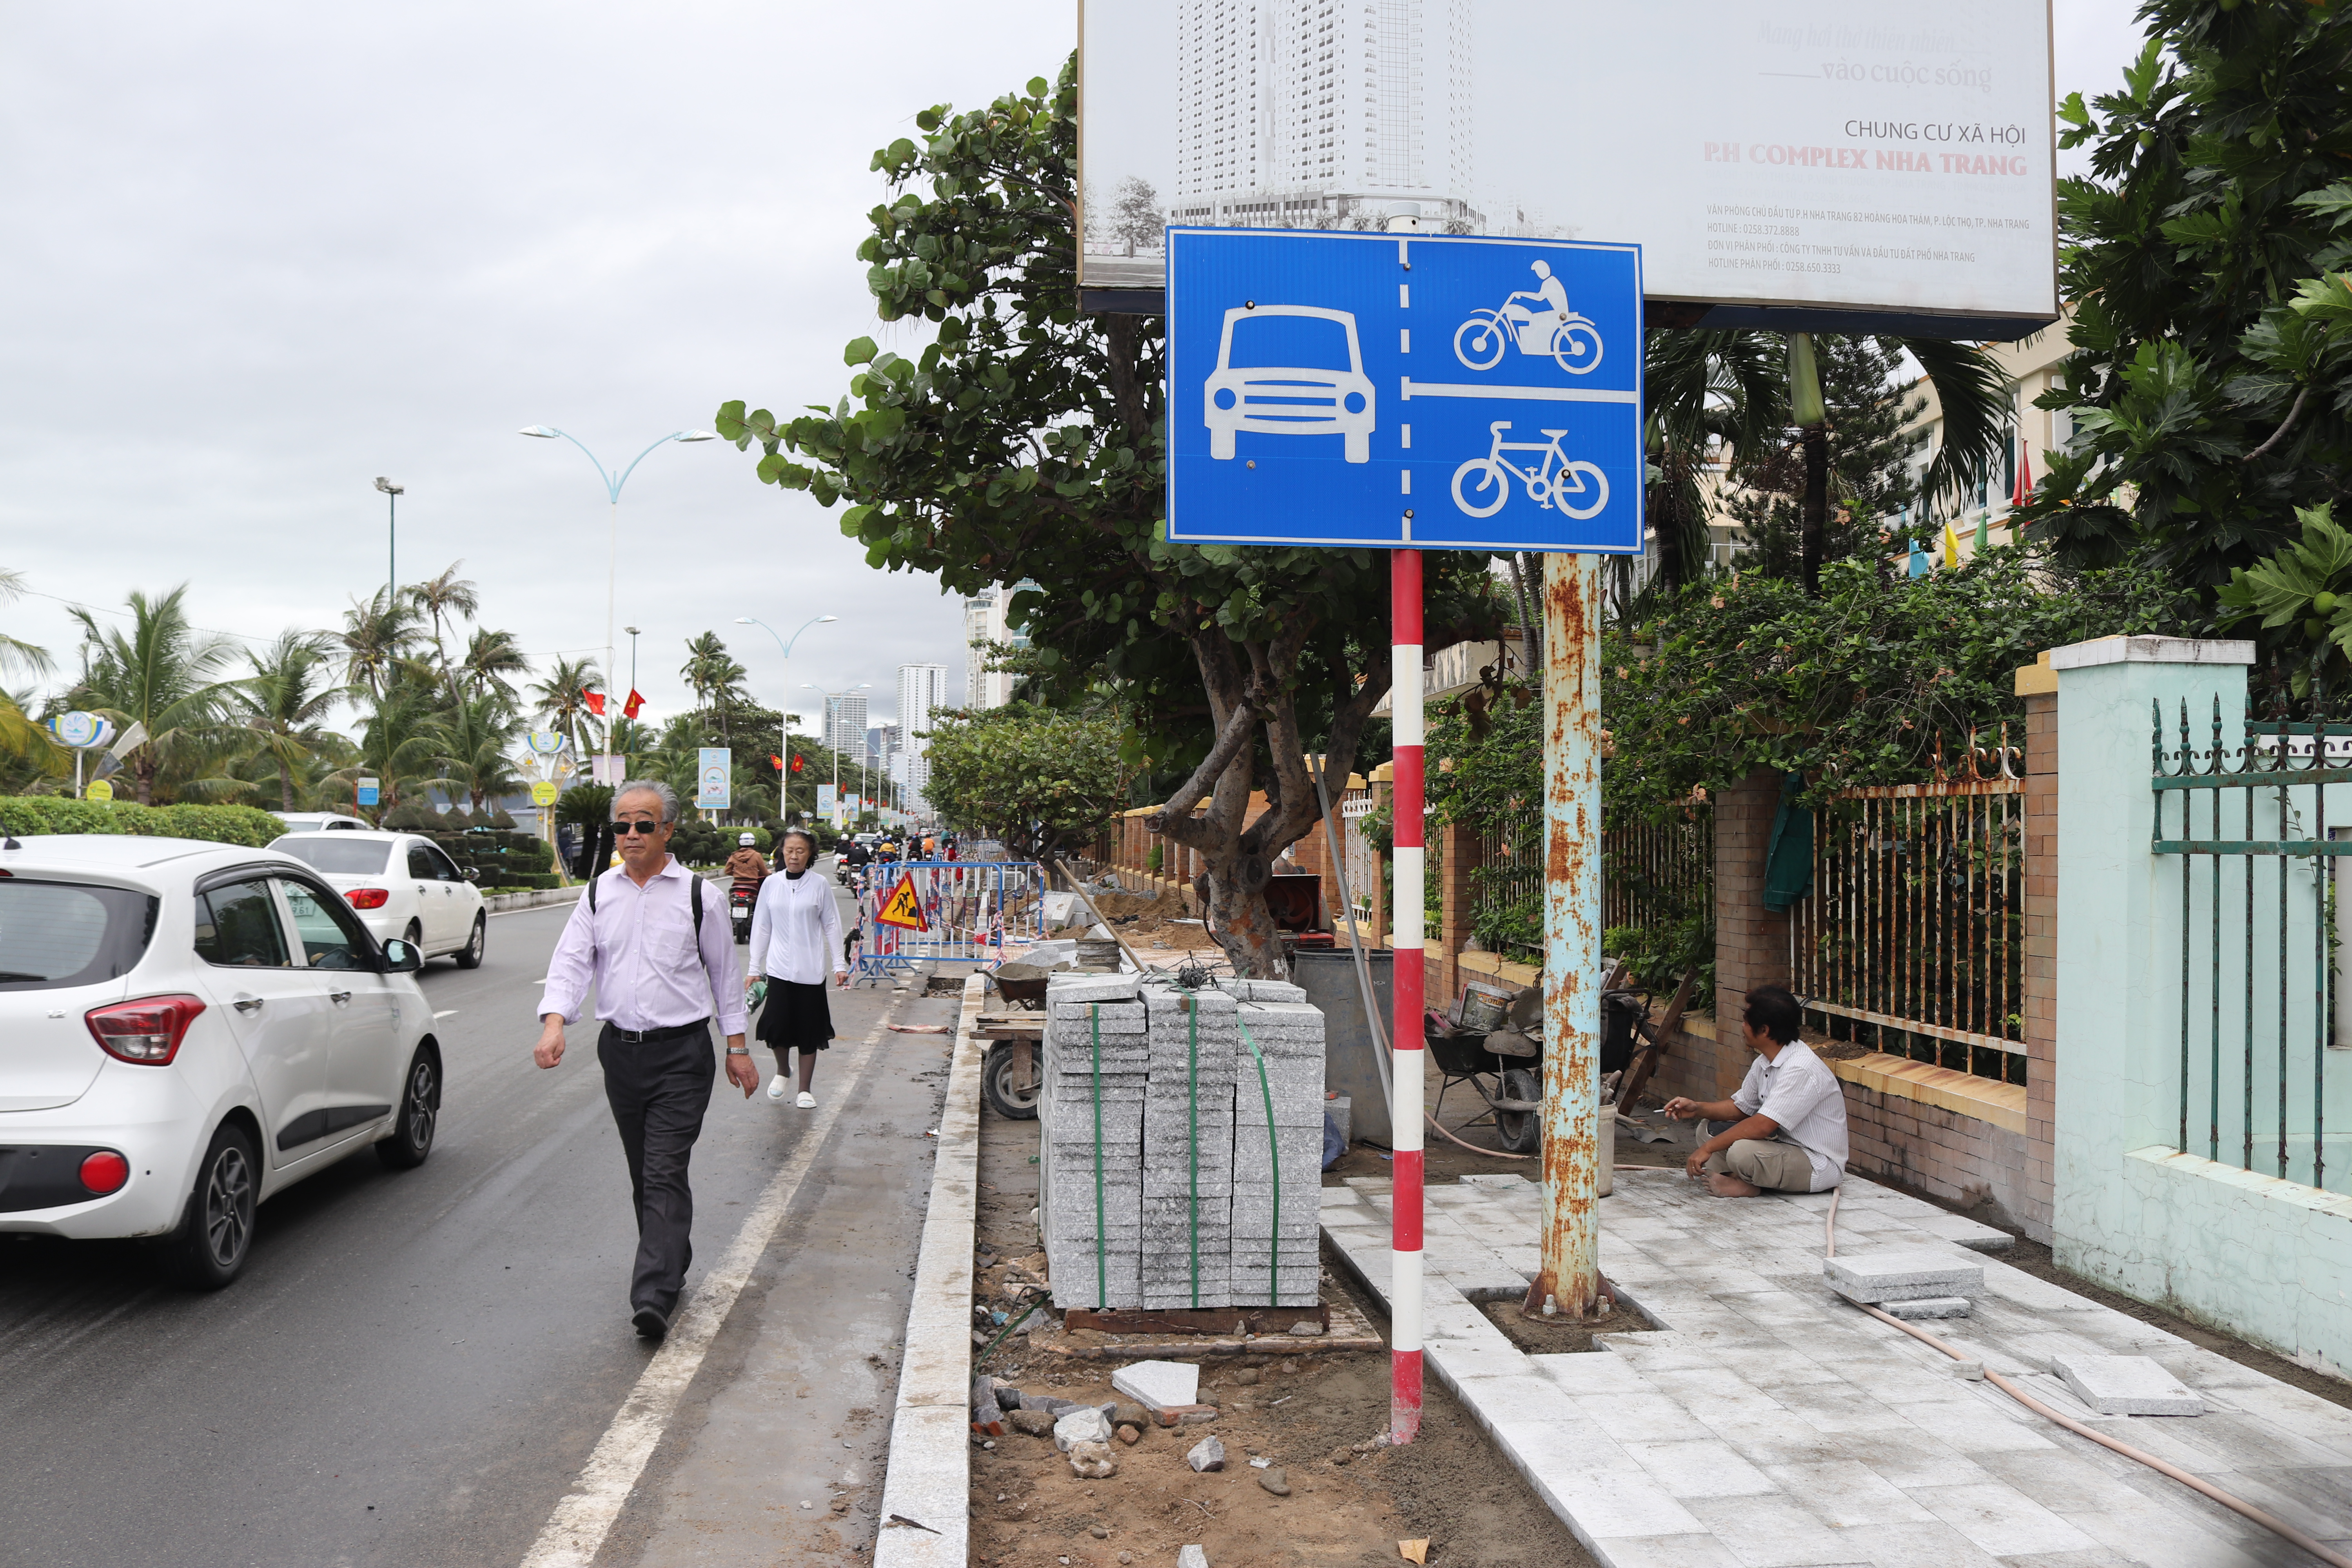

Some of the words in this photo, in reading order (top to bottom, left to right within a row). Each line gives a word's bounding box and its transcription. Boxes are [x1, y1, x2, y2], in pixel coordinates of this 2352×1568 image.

[1821, 56, 1866, 82] vào
[1870, 60, 1930, 88] cuộc
[1934, 59, 1992, 94] sống
[1845, 120, 1918, 140] CHUNG
[1924, 123, 1953, 141] CƯ
[1958, 123, 1984, 143] XÃ
[1991, 124, 2025, 148] HỘI
[1705, 142, 1740, 162] P.H
[1749, 144, 1868, 169] COMPLEX
[1875, 150, 1933, 172] NHA
[1939, 153, 2027, 176] TRANG
[1707, 203, 1722, 214] VĂN
[1724, 204, 1750, 216] PHÒNG
[1752, 205, 1766, 217] CHỦ
[1768, 205, 1783, 218] ĐẦU
[1785, 209, 1795, 218] TƯ
[1796, 209, 1808, 219] P.H
[1810, 210, 1826, 220] NHA
[1827, 211, 1851, 221] TRANG
[1853, 212, 1863, 222] 82
[1864, 211, 1890, 223] HOÀNG
[1892, 214, 1907, 224] HOA
[1909, 213, 1932, 227] THÁM,
[1934, 216, 1941, 225] P.
[1943, 214, 1955, 228] LỘC
[1957, 217, 1973, 229] THỌ,
[1975, 218, 1986, 228] TP.
[1987, 218, 2003, 228] NHA
[2005, 219, 2029, 229] TRANG
[1708, 223, 1737, 233] HOTLINE
[1744, 224, 1799, 236] 0258.372.8888
[1708, 240, 1724, 250] ĐƠN
[1726, 241, 1733, 252] VỊ
[1735, 240, 1755, 251] PHÂN
[1757, 240, 1774, 252] PHỐI
[1780, 241, 1800, 254] CÔNG
[1802, 245, 1810, 254] TY
[1812, 245, 1831, 255] TNHH
[1833, 246, 1842, 256] TƯ
[1844, 244, 1859, 257] VẤN
[1861, 245, 1871, 257] VÀ
[1873, 245, 1888, 258] ĐẦU
[1890, 249, 1899, 259] TƯ
[1901, 247, 1915, 259] ĐẤT
[1917, 247, 1931, 260] PHỐ
[1933, 251, 1949, 260] NHA
[1950, 252, 1975, 262] TRANG
[1709, 258, 1739, 268] HOTLINE
[1740, 258, 1761, 269] PHÂN
[1763, 258, 1780, 270] PHỐI
[1786, 261, 1840, 274] 0258.650.3333
